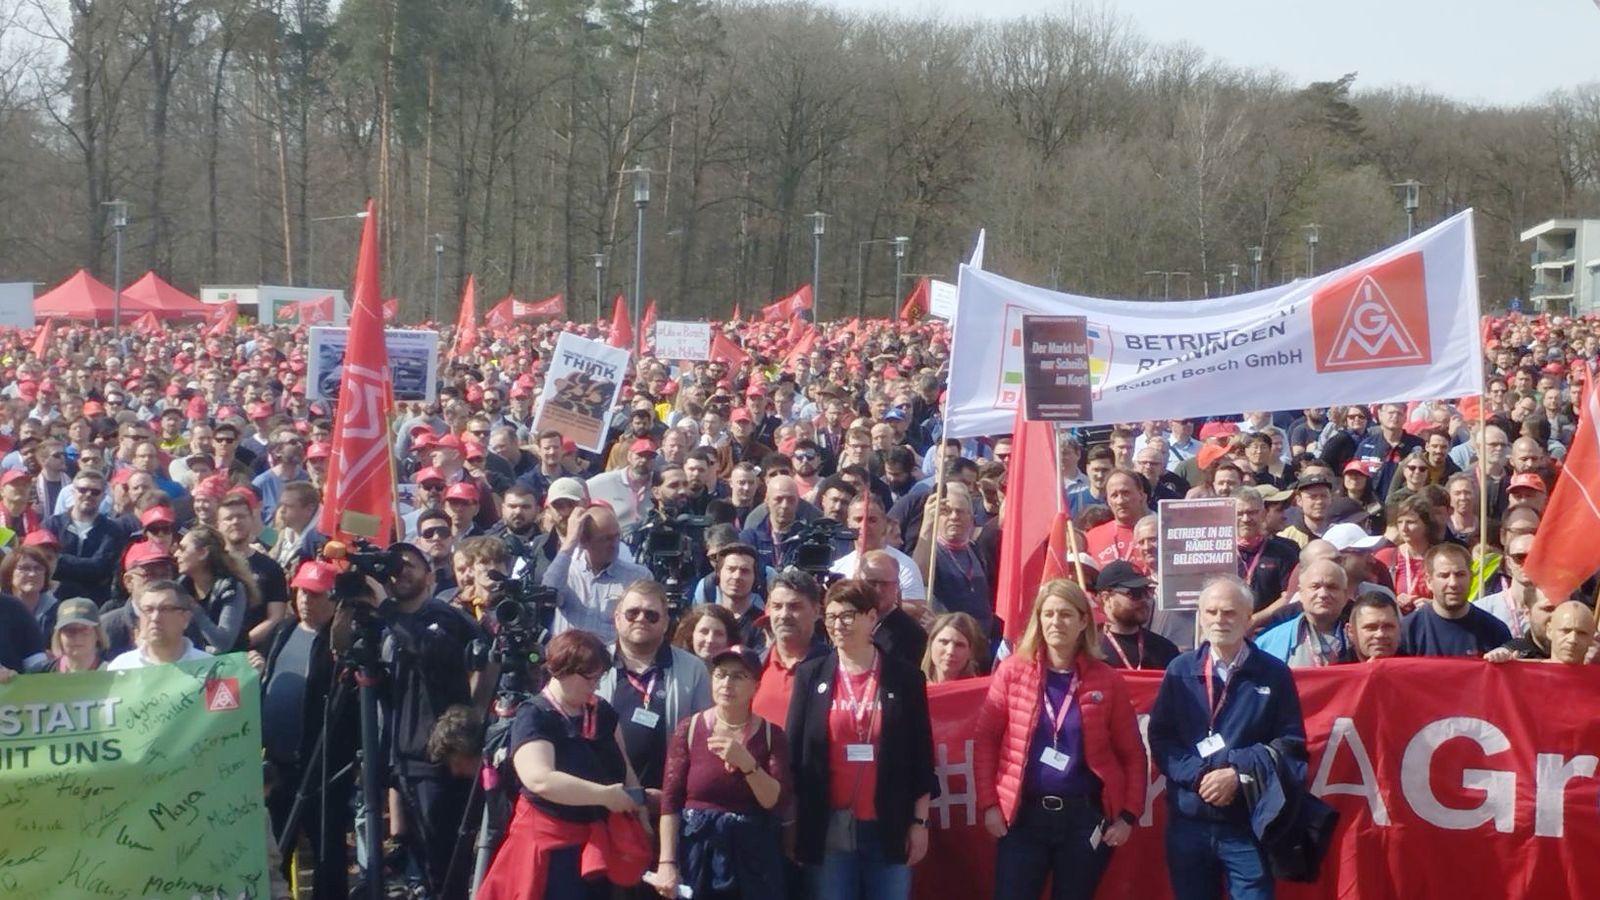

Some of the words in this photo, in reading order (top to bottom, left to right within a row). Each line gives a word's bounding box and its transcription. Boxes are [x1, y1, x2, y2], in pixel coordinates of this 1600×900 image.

[1032, 342, 1047, 354] Der
[1048, 342, 1072, 354] Markt
[1074, 342, 1087, 354] hat
[563, 354, 615, 380] THINK
[1182, 359, 1239, 380] Bosch
[1245, 348, 1303, 369] GmbH
[1055, 374, 1067, 385] im
[1167, 527, 1207, 540] BETRIEBE
[1207, 526, 1218, 539] IN
[1218, 526, 1233, 538] DIE
[1185, 539, 1214, 552] HÄNDE
[1215, 538, 1233, 551] DER
[1173, 552, 1233, 565] BELEGSCHAFT!
[0, 697, 123, 737] STATT
[0, 746, 36, 770] IT
[49, 738, 122, 766] UNS
[148, 790, 206, 831] Maja
[58, 849, 133, 899] Klaus
